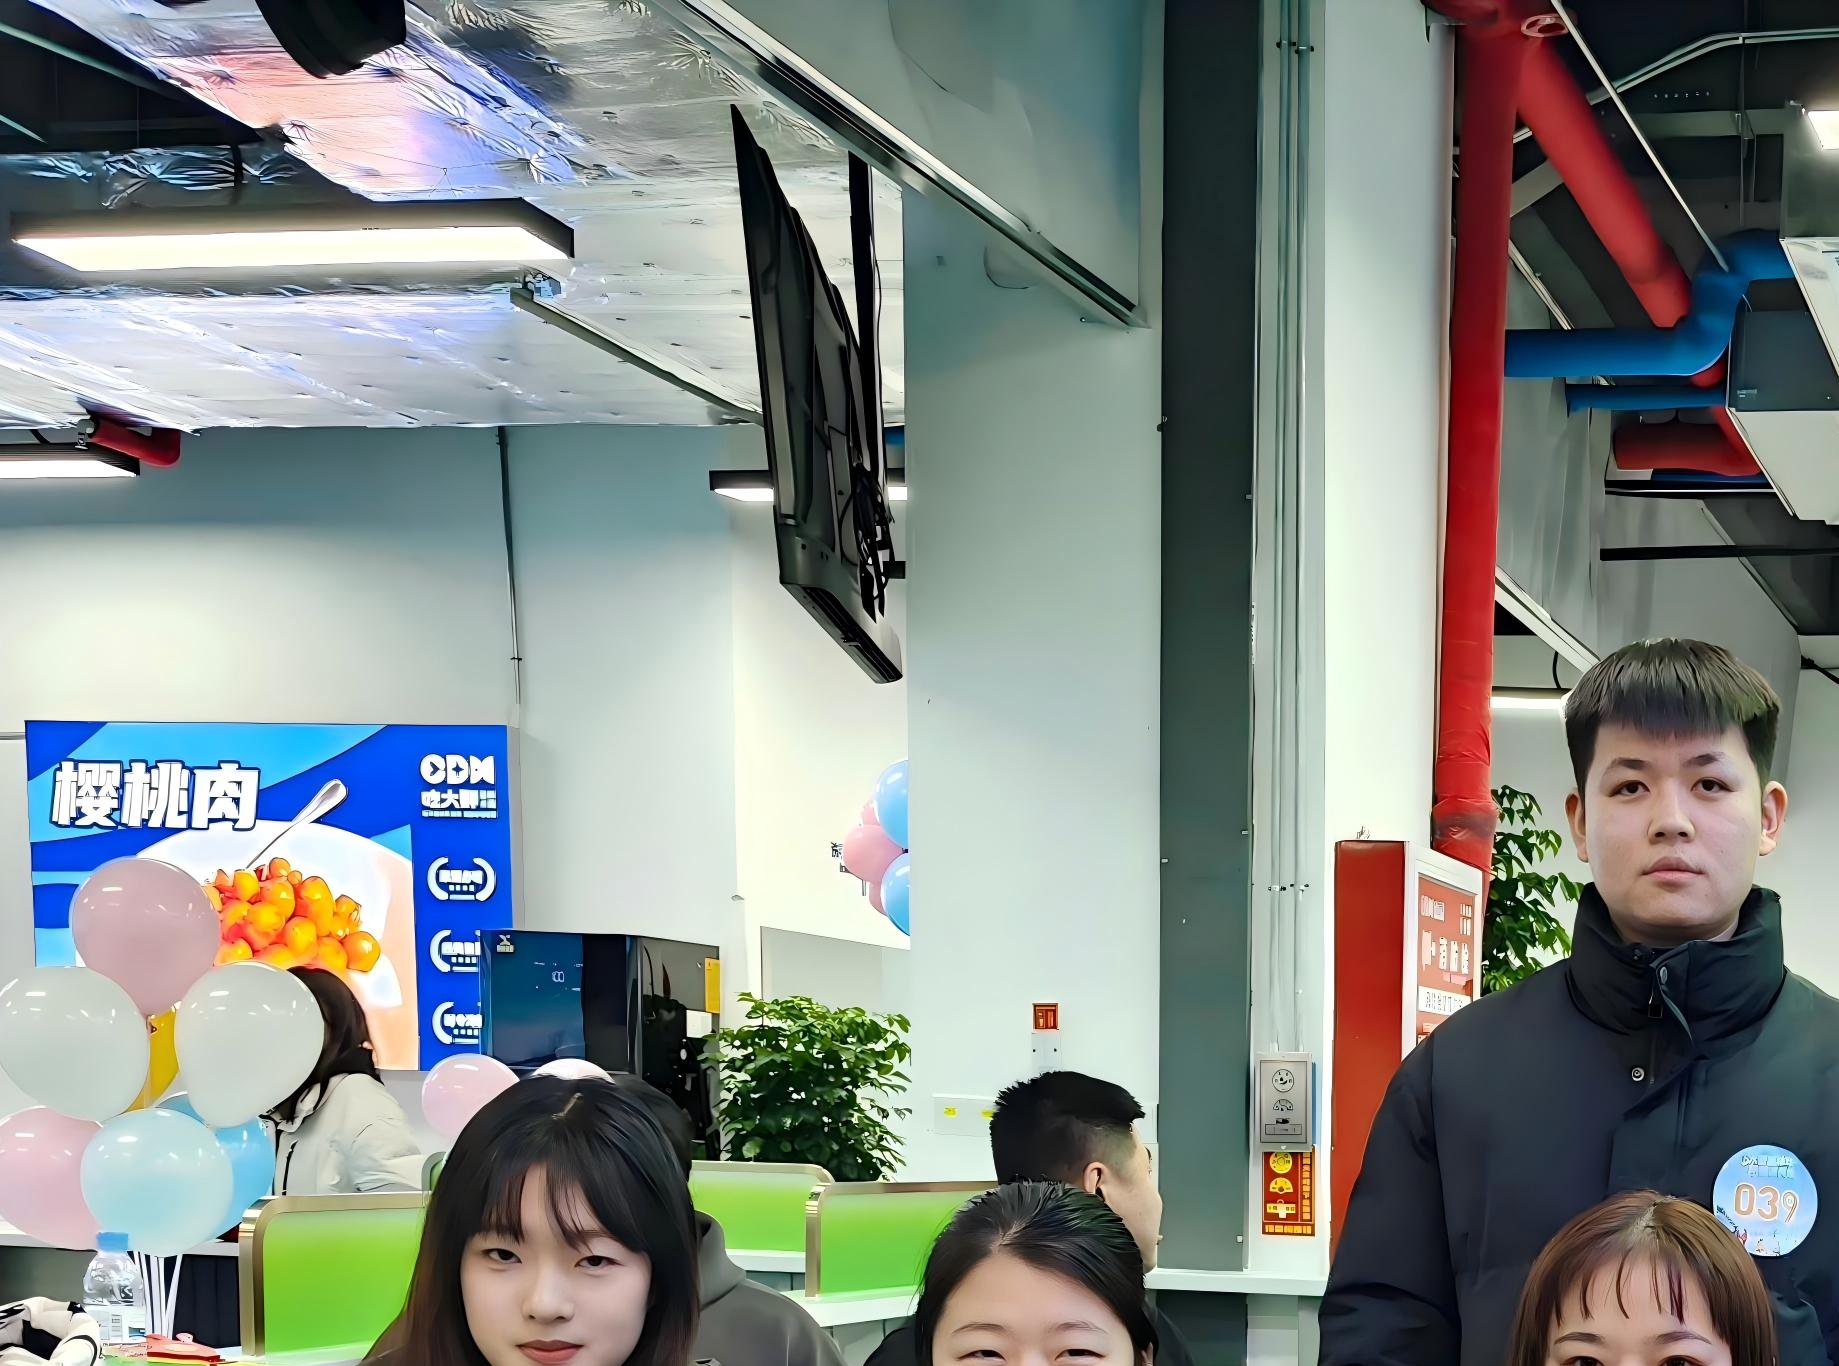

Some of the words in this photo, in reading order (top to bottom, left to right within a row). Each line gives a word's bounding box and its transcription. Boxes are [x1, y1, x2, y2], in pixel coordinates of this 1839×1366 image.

[51, 760, 260, 831] 樱桃肉
[1734, 1182, 1799, 1223] 039
